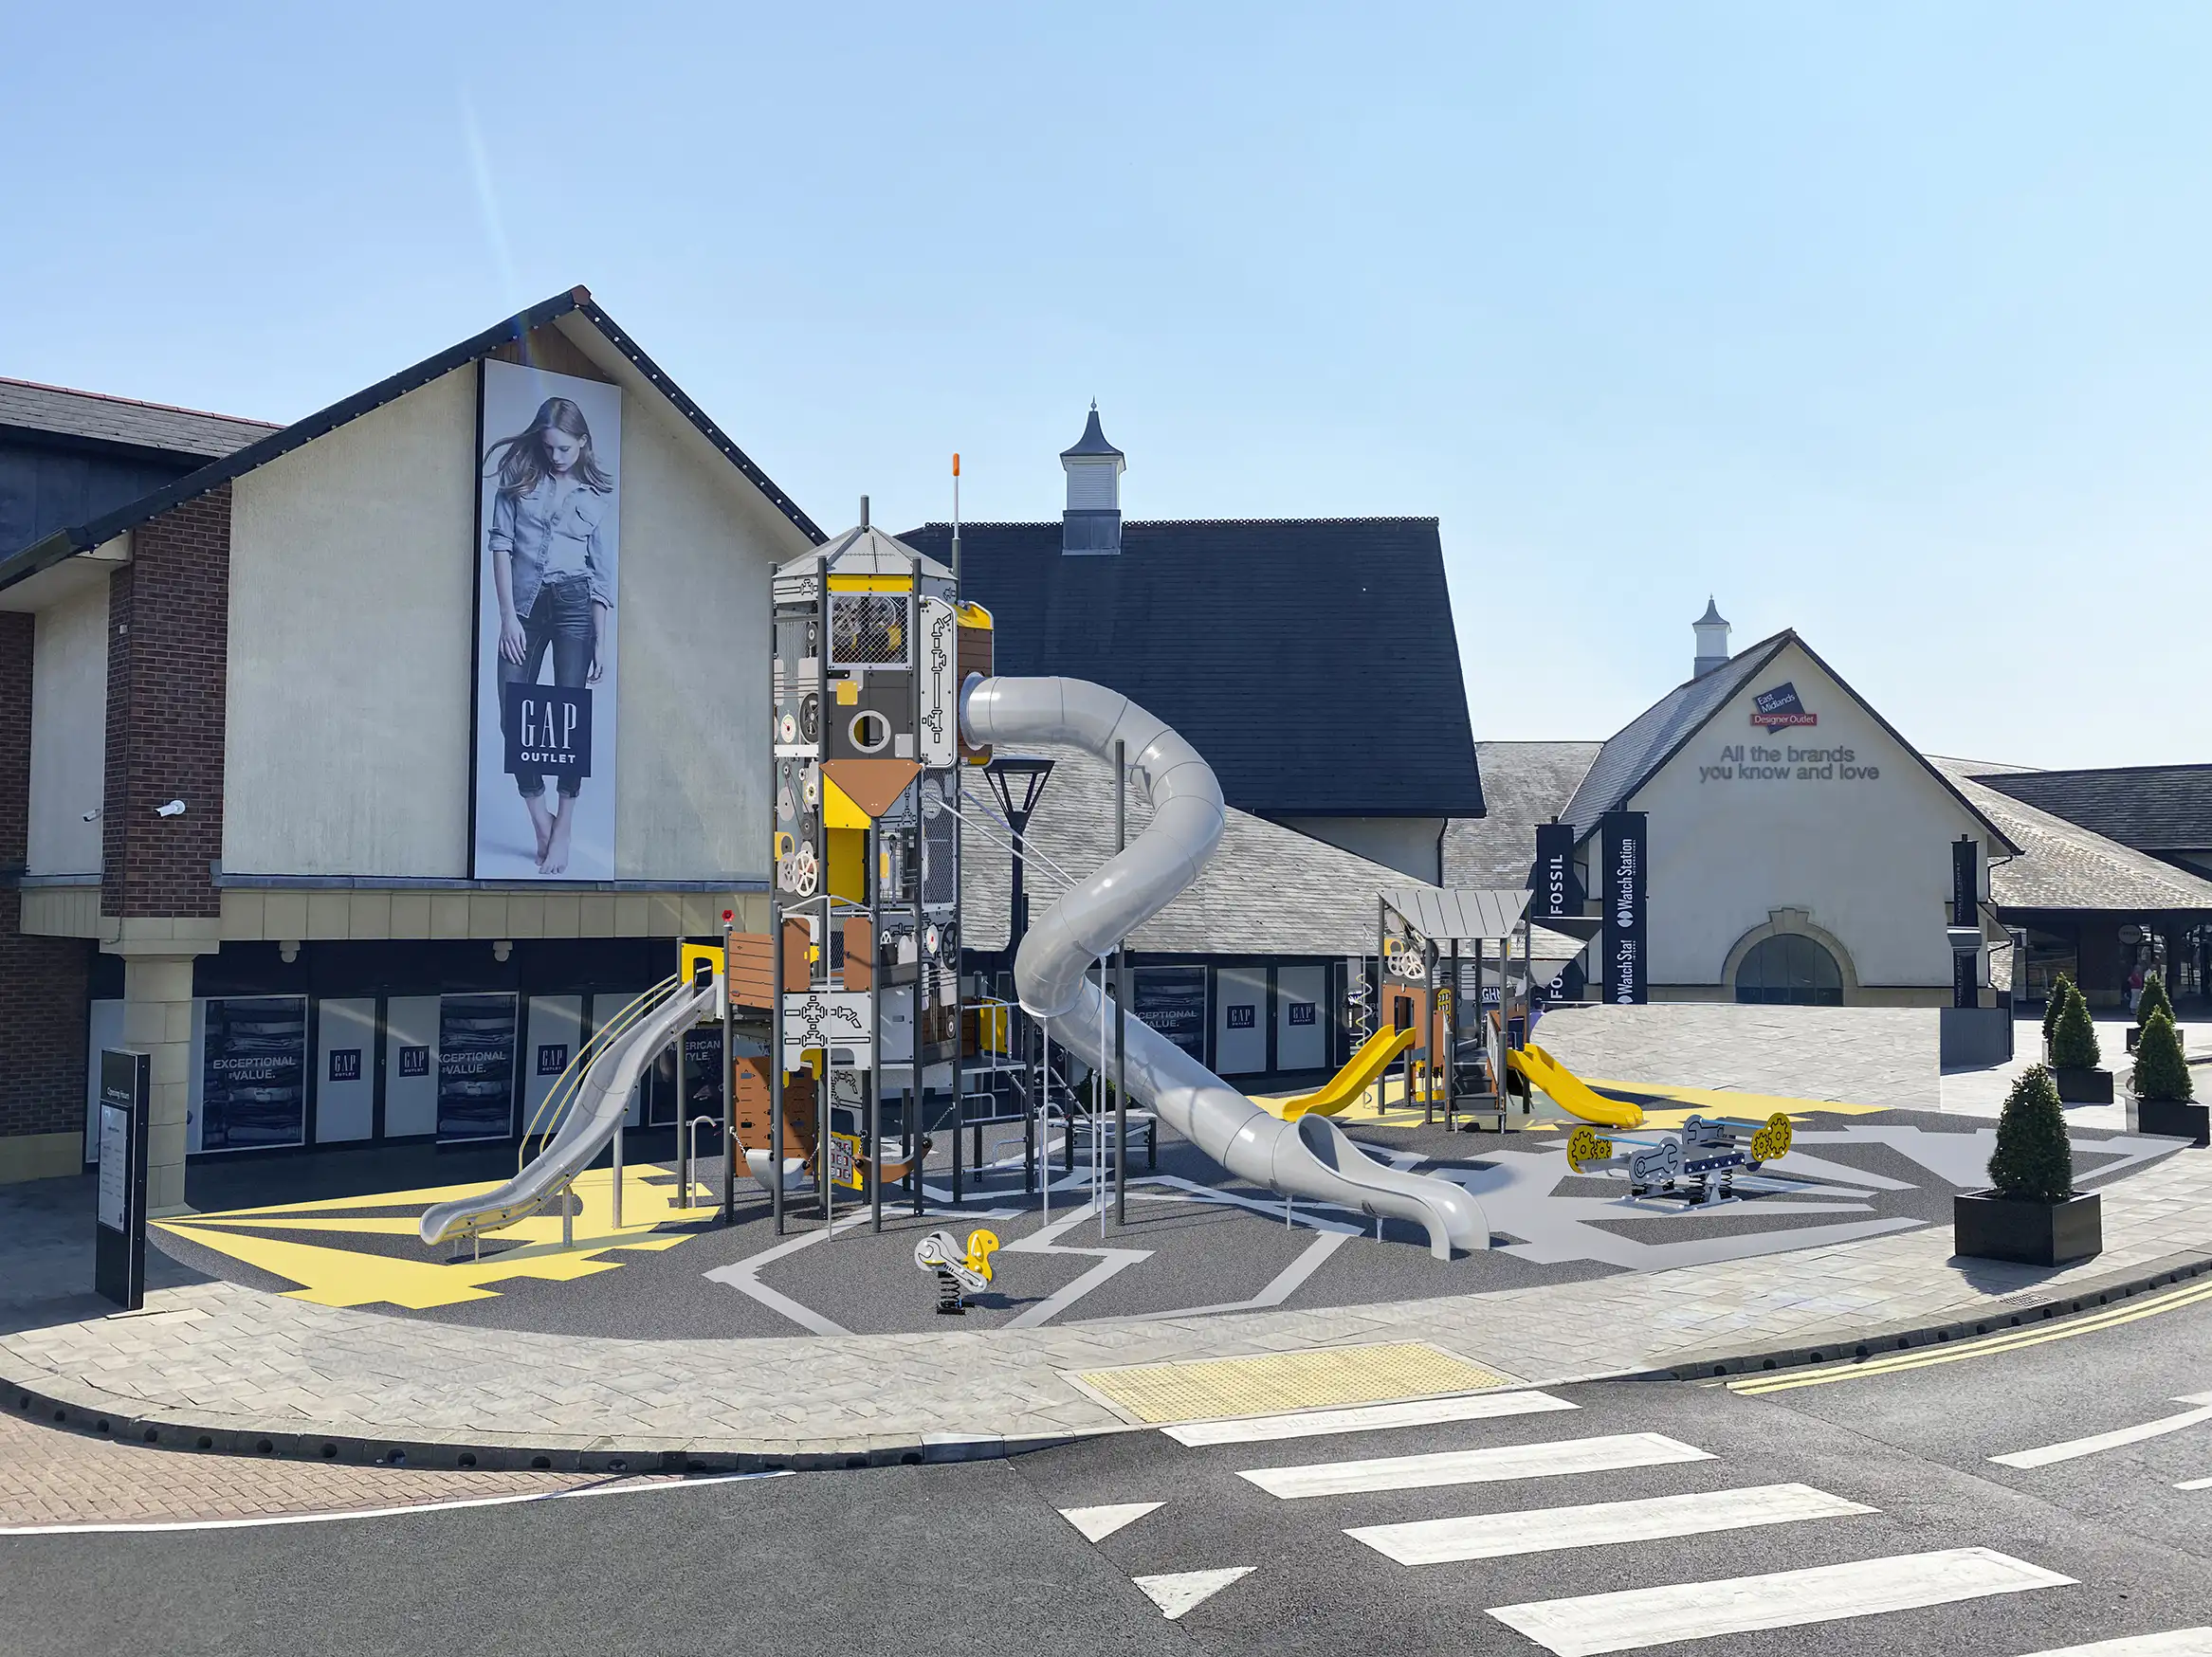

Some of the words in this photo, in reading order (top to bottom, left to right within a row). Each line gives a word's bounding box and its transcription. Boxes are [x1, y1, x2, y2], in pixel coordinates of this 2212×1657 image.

[1757, 693, 1774, 705] East
[1761, 693, 1796, 713] Midlands
[521, 699, 577, 750] GAP
[1754, 715, 1789, 725] Designer
[1789, 715, 1815, 724] Outlet
[521, 751, 576, 764] OUTLET
[1720, 745, 1745, 762] All
[1749, 745, 1782, 762] the
[1787, 745, 1856, 762] brands
[1699, 766, 1732, 784] you
[1738, 763, 1791, 780] know
[1797, 763, 1833, 780] and
[1839, 763, 1880, 780] love
[1617, 838, 1633, 876] Station
[1550, 854, 1563, 915] FOSSIL
[1617, 878, 1634, 911] Watch
[1617, 961, 1634, 995] Watch
[1232, 1009, 1251, 1022] GAP
[1292, 1007, 1311, 1019] GAP
[1146, 1019, 1179, 1029] ALUE.
[212, 1056, 297, 1069] EXCEPTIONAL
[335, 1054, 356, 1072] GAP
[404, 1051, 425, 1068] GAP
[542, 1049, 563, 1066] GAP
[685, 1051, 710, 1062] TYLE.
[232, 1069, 276, 1080] VALUE.
[446, 1063, 487, 1074] VALUE.
